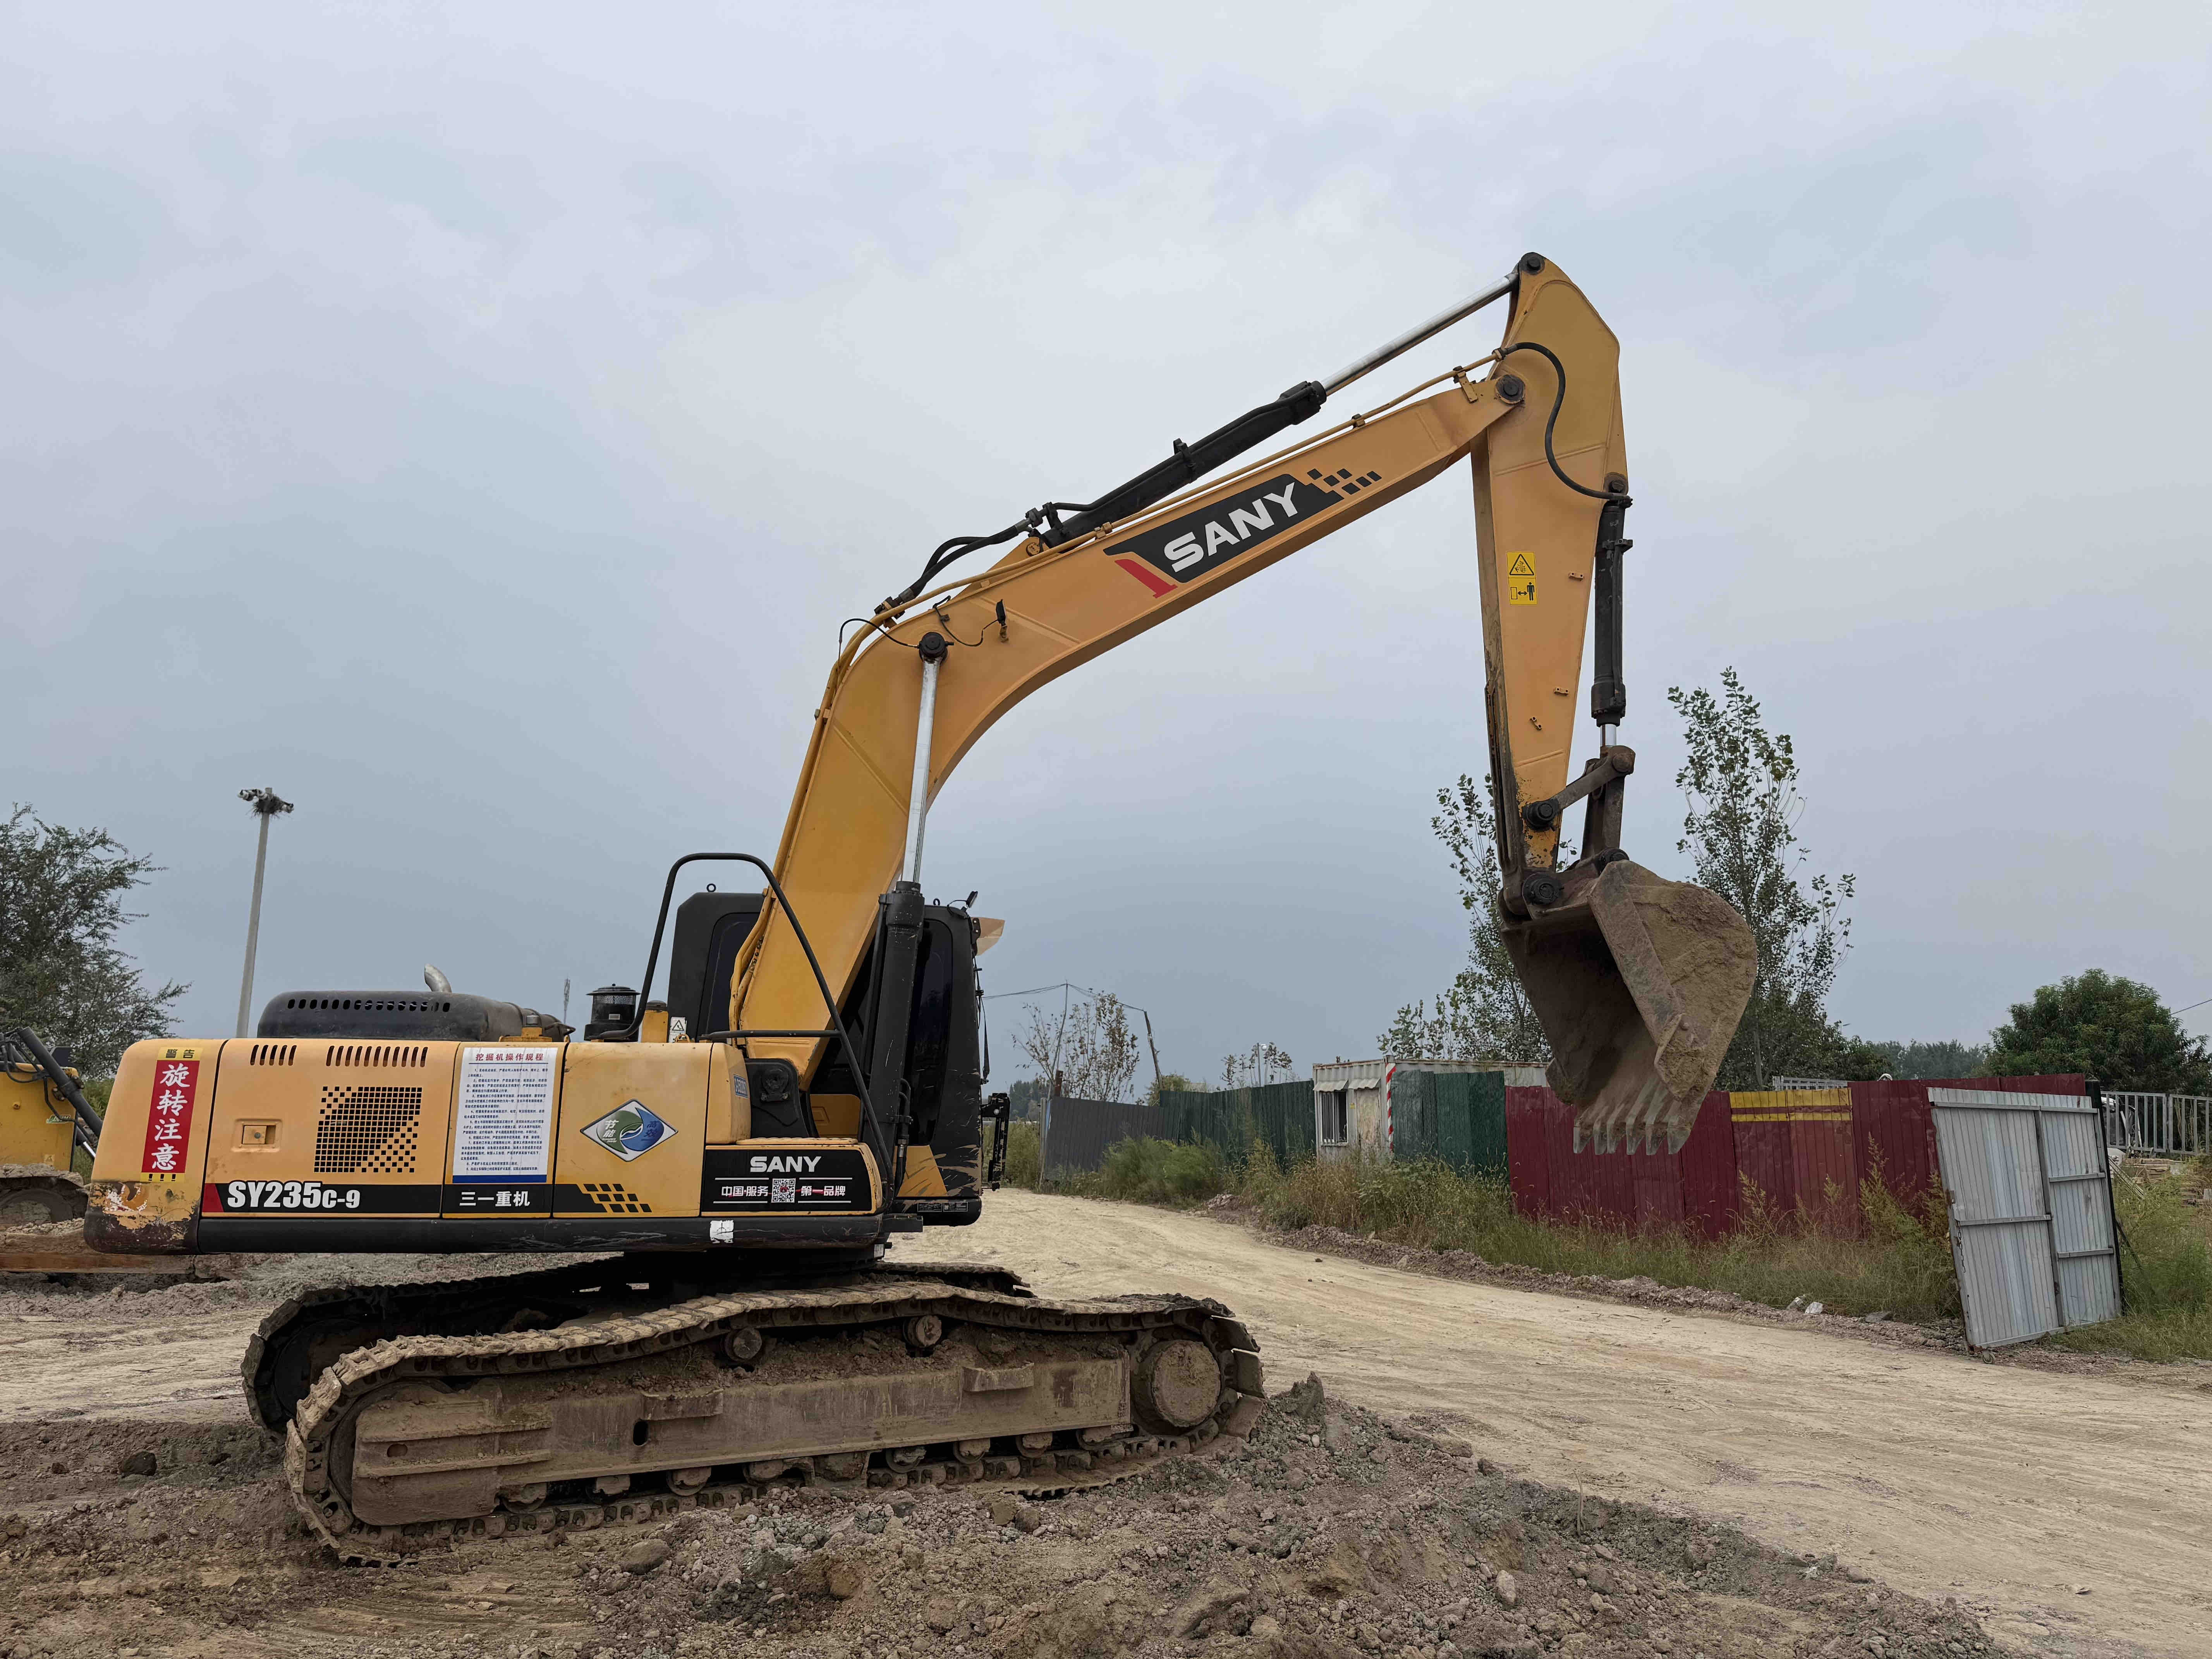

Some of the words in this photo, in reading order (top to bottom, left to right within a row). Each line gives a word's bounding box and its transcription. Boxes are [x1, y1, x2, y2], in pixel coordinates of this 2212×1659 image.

[1164, 482, 1298, 573] SANY
[165, 1049, 195, 1059] 警告
[476, 1053, 544, 1061] 挖掘机操作规程
[152, 1063, 190, 1171] 旋转注意
[750, 1156, 821, 1173] SANY
[459, 1191, 530, 1207] 三一重机
[800, 1185, 846, 1197] 第一品牌
